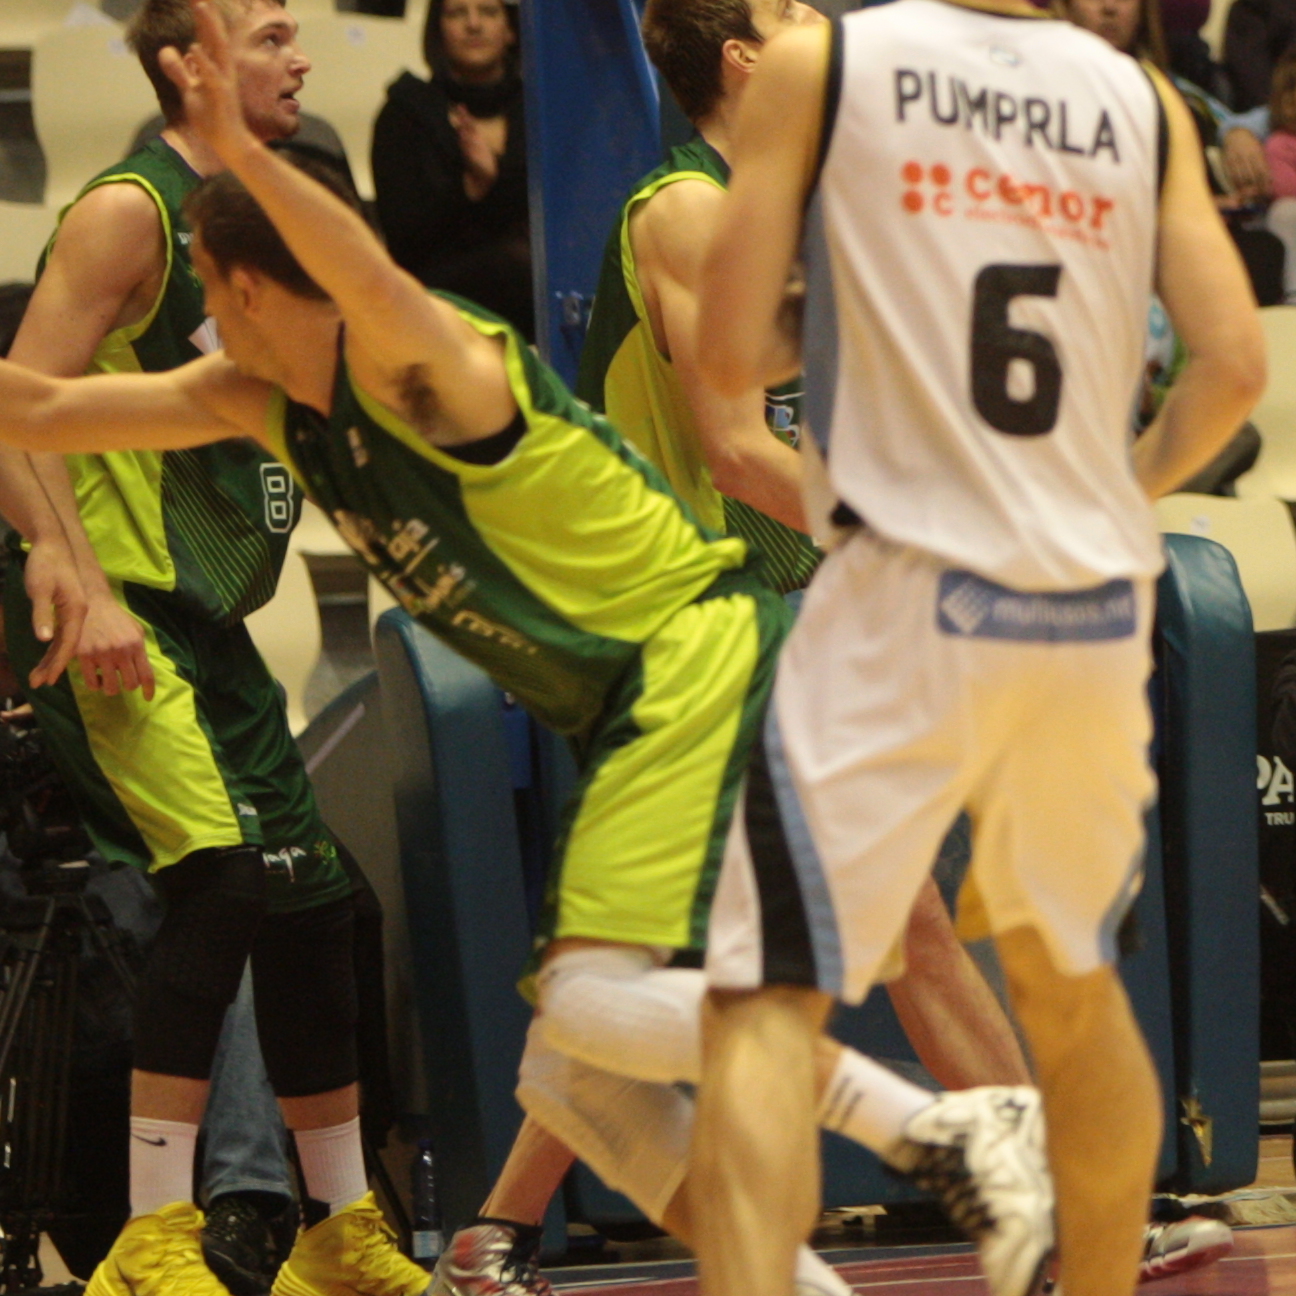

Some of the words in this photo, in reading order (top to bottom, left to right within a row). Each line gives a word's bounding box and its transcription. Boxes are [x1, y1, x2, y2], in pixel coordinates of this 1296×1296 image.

[894, 69, 1121, 164] PUMPRLA
[970, 263, 1063, 436] 6
[259, 462, 294, 533] 8
